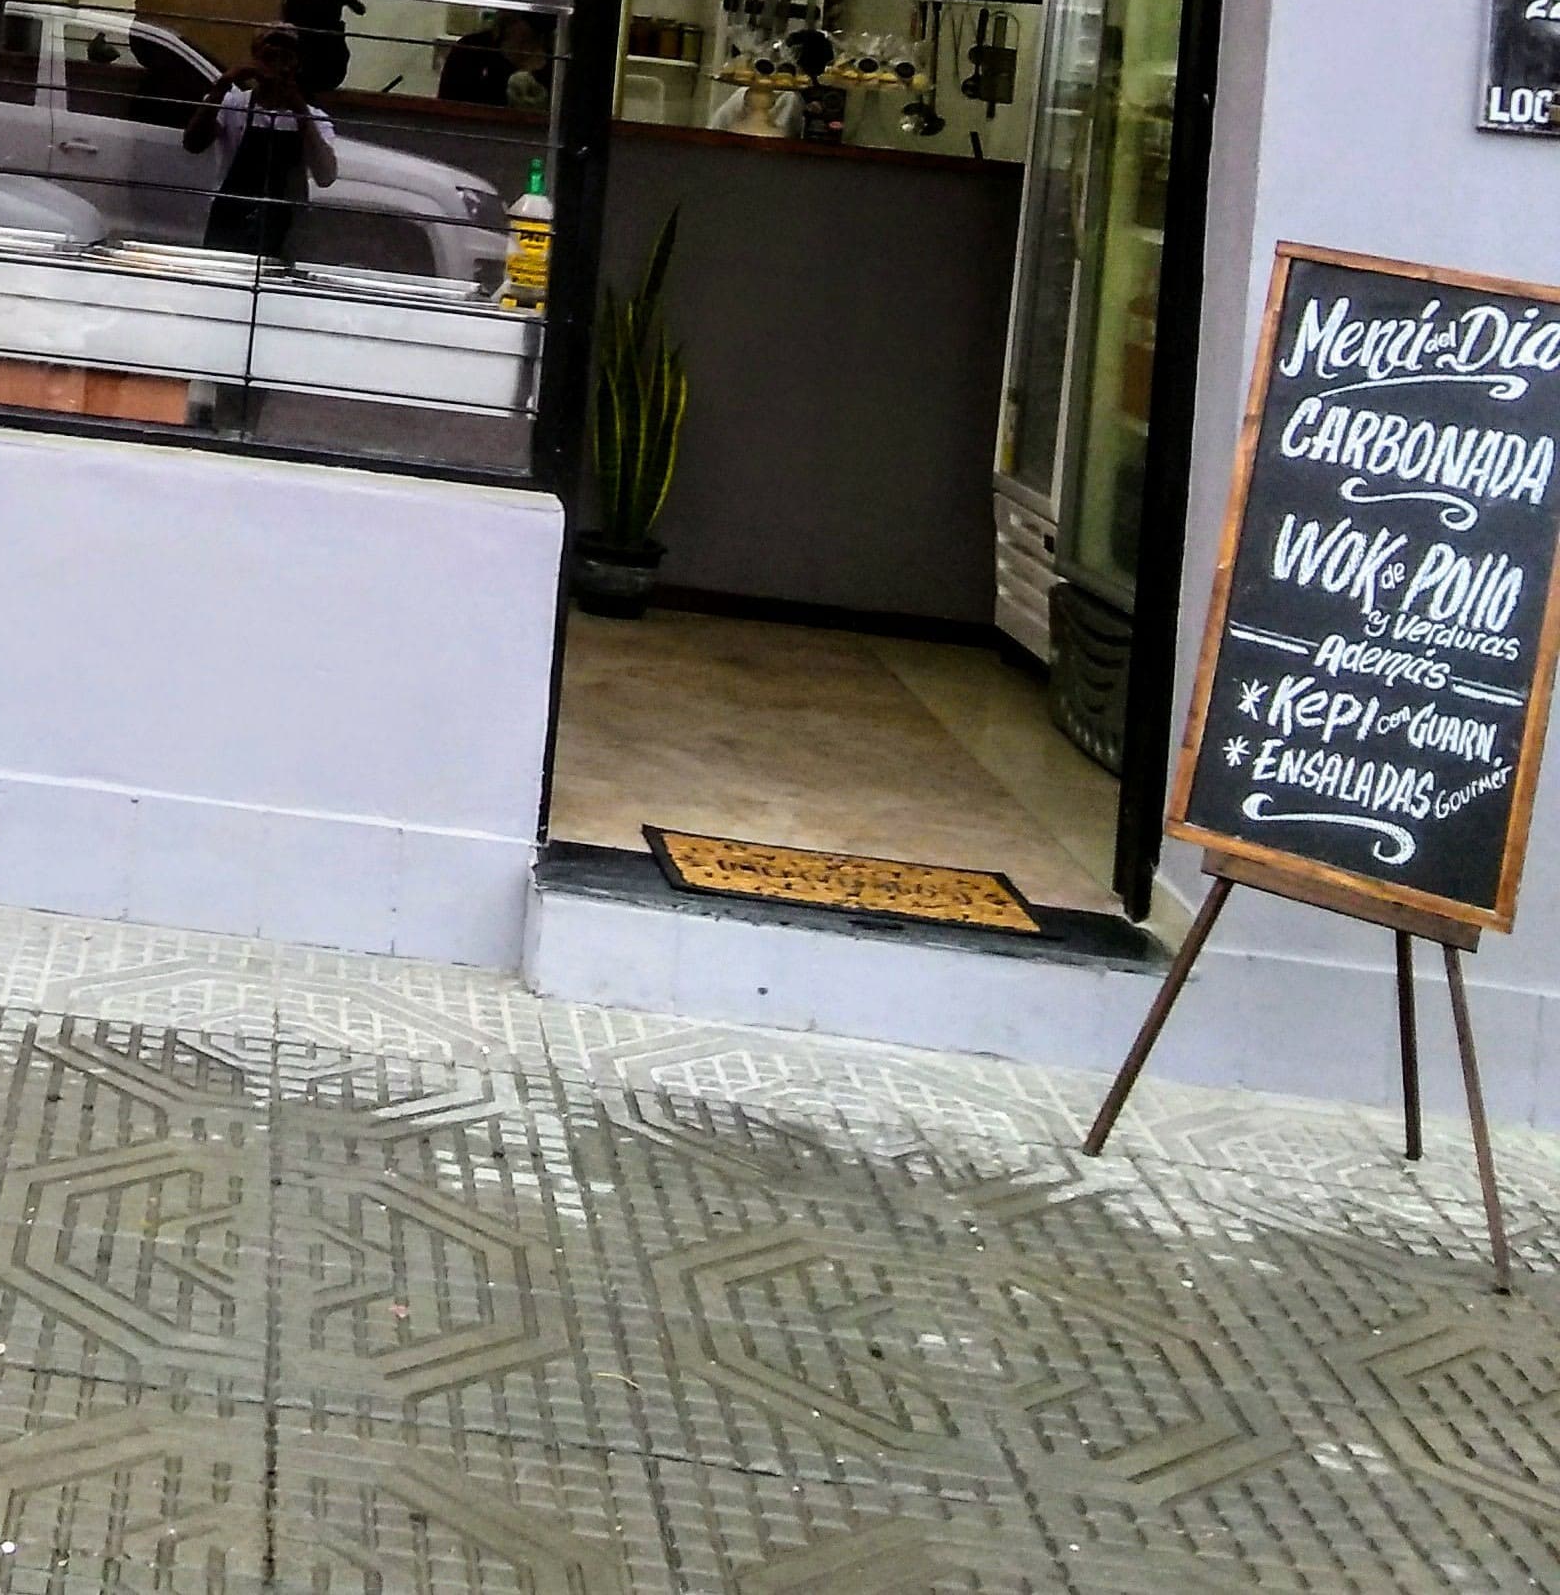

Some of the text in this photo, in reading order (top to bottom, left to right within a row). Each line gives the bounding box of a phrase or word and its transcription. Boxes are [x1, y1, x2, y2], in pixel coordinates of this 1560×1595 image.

[1279, 297, 1441, 380] Menú
[1424, 320, 1457, 354] del
[1280, 396, 1555, 504] CARBONADA
[1271, 513, 1409, 615] WOK
[1381, 562, 1406, 590] de
[1313, 633, 1452, 690] Además
[1364, 610, 1390, 638] y
[1376, 705, 1412, 736] con
[1251, 738, 1435, 821] ENSALADAS
